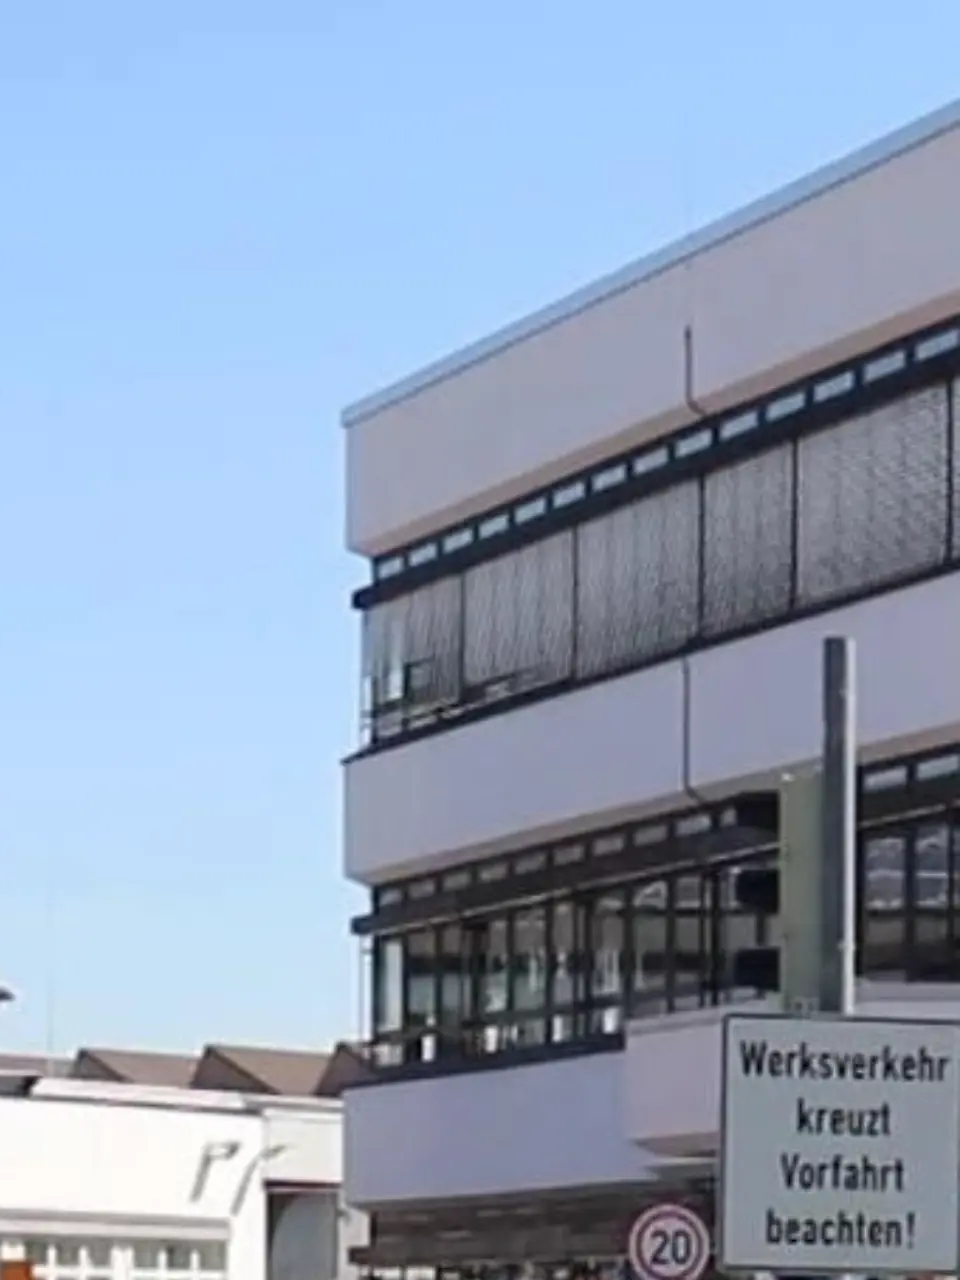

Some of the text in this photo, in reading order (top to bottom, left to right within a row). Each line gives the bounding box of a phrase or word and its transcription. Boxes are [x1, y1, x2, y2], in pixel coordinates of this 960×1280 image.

[740, 1040, 951, 1081] Werksverkehr
[796, 1098, 891, 1136] kreuzt
[781, 1153, 904, 1192] Vorfahrt
[650, 1229, 692, 1265] 20
[766, 1207, 916, 1249] beachten!
